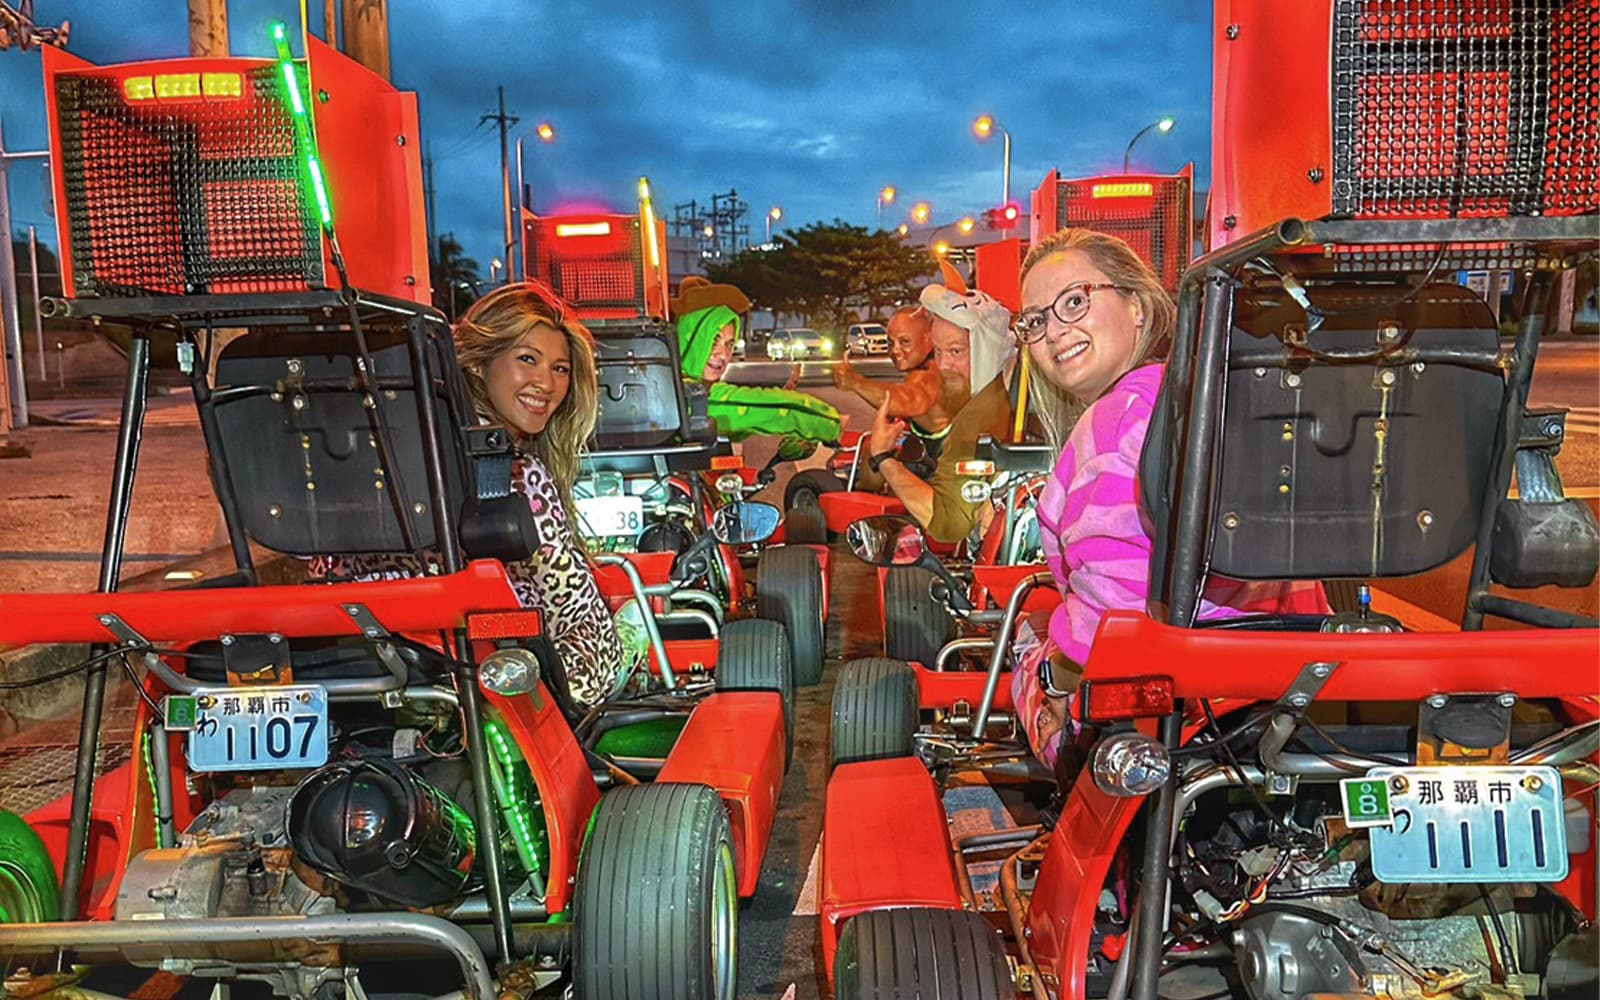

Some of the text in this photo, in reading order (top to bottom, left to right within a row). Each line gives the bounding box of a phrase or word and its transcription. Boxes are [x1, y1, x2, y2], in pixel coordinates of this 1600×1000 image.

[223, 697, 290, 715] 那覇市
[197, 712, 319, 761] わ 1107
[1359, 795, 1378, 814] 8
[1418, 779, 1512, 805] 那覇市
[1426, 809, 1546, 868] 1111
